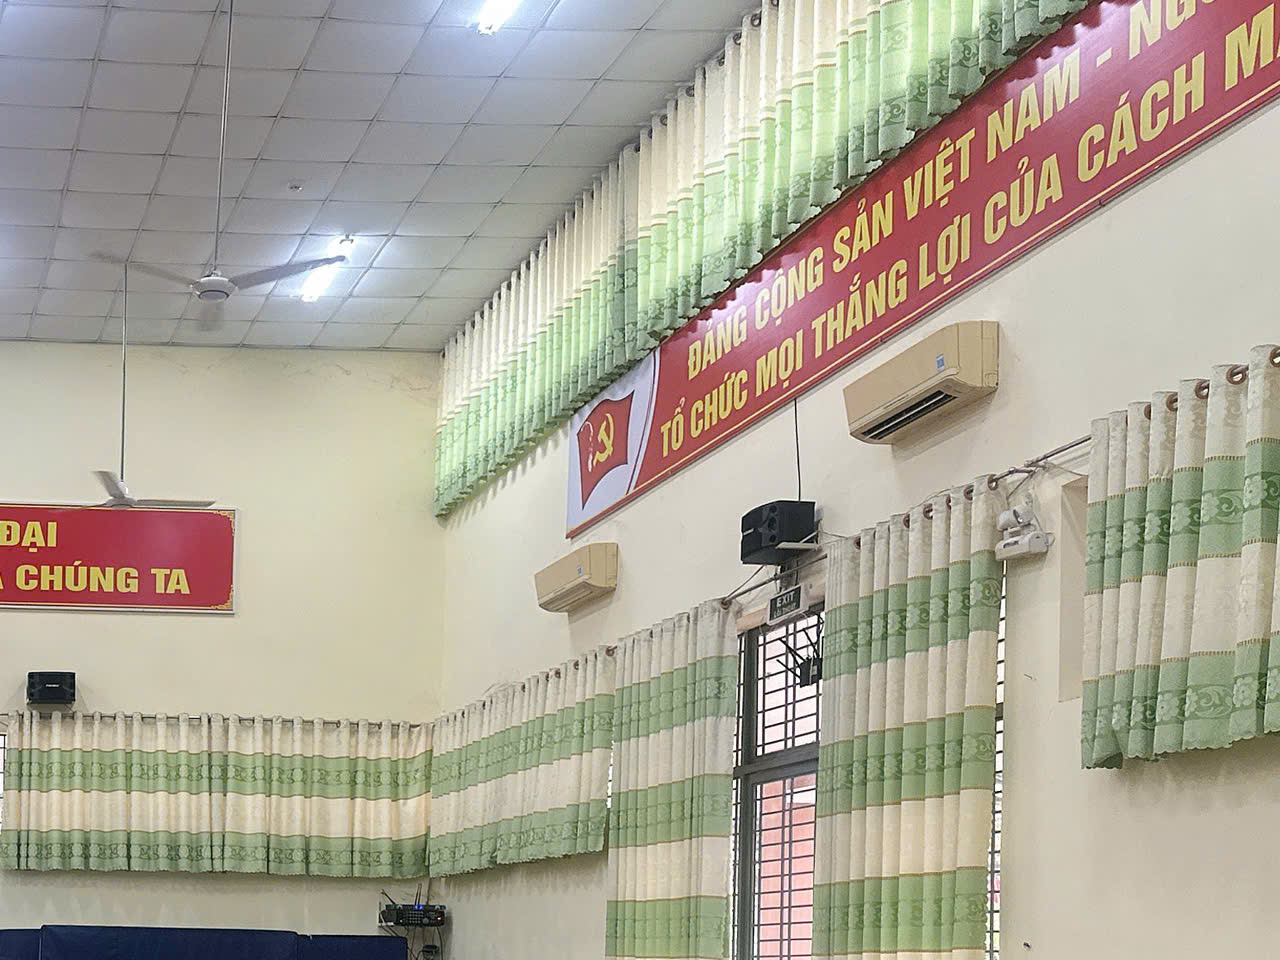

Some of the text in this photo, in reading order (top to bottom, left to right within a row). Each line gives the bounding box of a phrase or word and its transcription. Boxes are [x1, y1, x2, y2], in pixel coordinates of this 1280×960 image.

[660, 2, 1280, 457] TỔ CHỨC MỌI THẮNG LỢI CỦA CÁCH M
[687, 306, 748, 381] ĐẢNG
[754, 247, 824, 327] CỘNG
[832, 190, 893, 273] SẢN
[904, 128, 975, 221] VIỆT
[986, 47, 1080, 164] NAM
[1128, 0, 1217, 61] NG
[15, 560, 139, 593] CHÚNG
[150, 568, 190, 594] TA
[776, 591, 795, 607] EXIT
